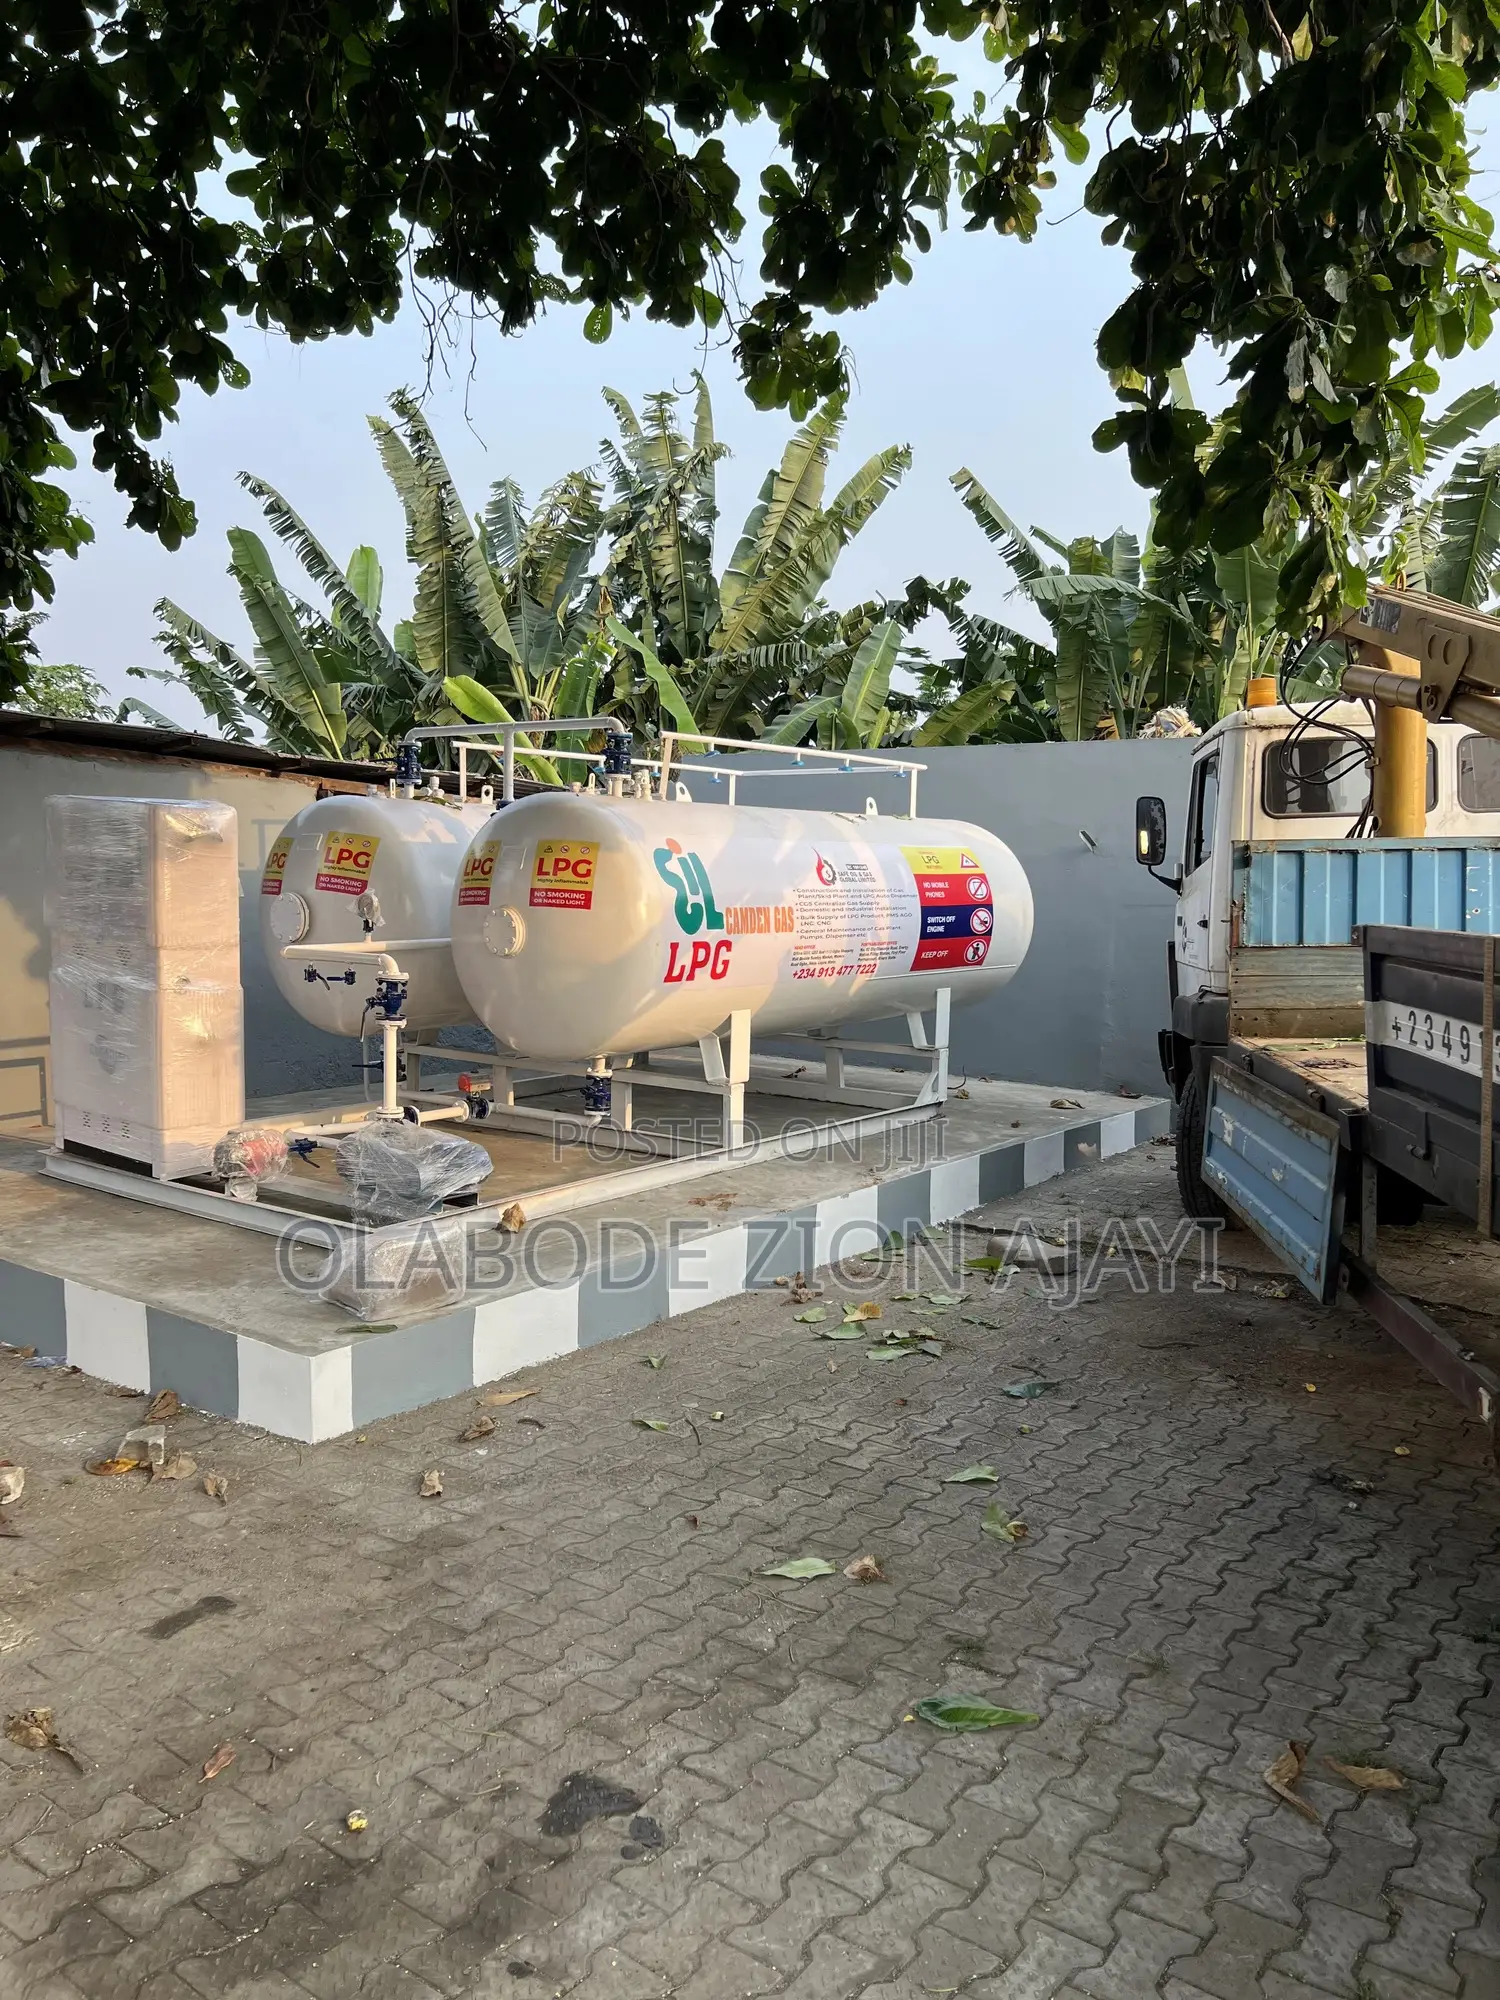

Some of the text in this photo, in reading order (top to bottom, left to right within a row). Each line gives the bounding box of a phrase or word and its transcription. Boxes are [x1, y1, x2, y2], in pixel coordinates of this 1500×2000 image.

[323, 846, 372, 869] LPG
[921, 855, 940, 864] LPG
[463, 857, 494, 877] LPG
[536, 857, 593, 879] LPG
[330, 877, 362, 887] SMOKING
[546, 891, 586, 899] SMOKING
[725, 906, 795, 935] CAMDEN GAS
[945, 915, 956, 923] OFF
[926, 925, 945, 933] ENGINE
[663, 939, 733, 983] LPG
[921, 950, 949, 959] KEEP OFF
[793, 963, 877, 979] +234 913 477 7222
